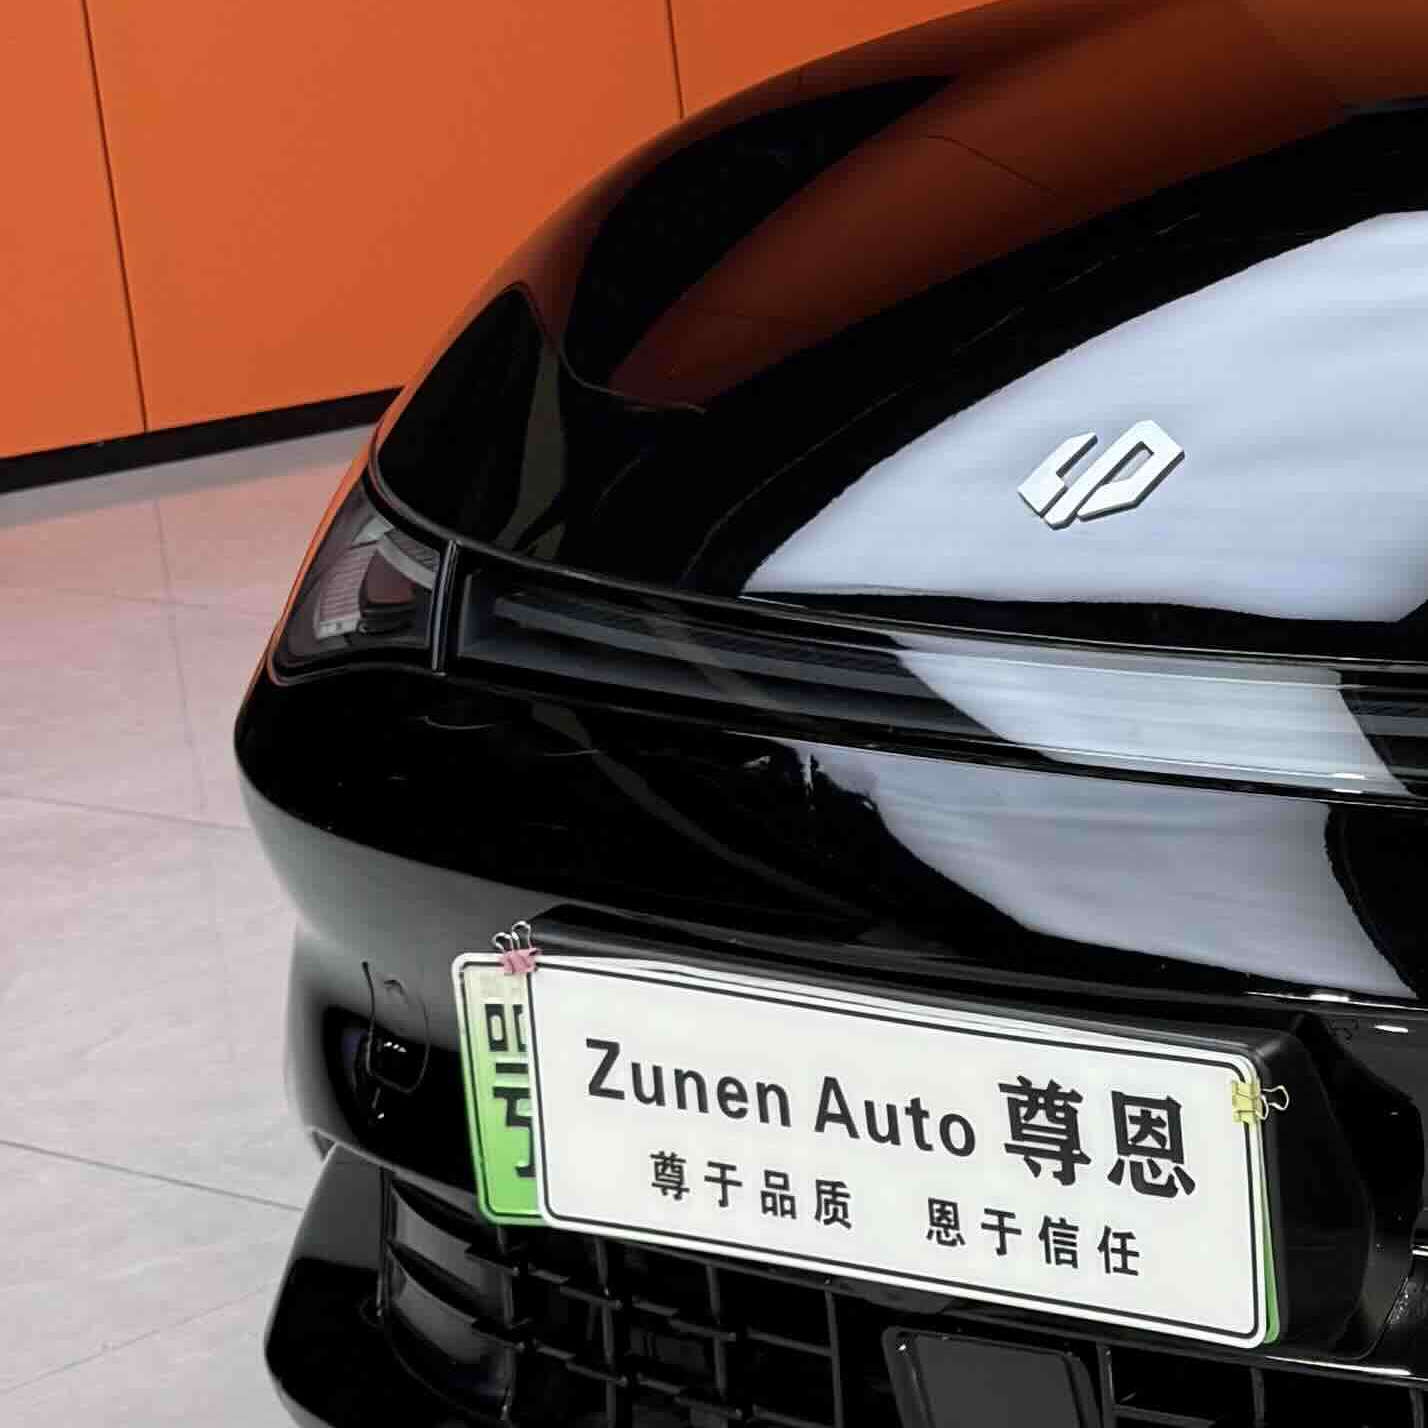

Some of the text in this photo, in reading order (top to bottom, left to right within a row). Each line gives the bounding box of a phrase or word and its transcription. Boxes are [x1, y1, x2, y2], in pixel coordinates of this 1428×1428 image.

[586, 1038, 791, 1128] Zunen
[814, 1076, 976, 1158] Auto
[998, 1074, 1197, 1199] 尊恩
[649, 1150, 1140, 1278] 尊于品质 恩于信任
